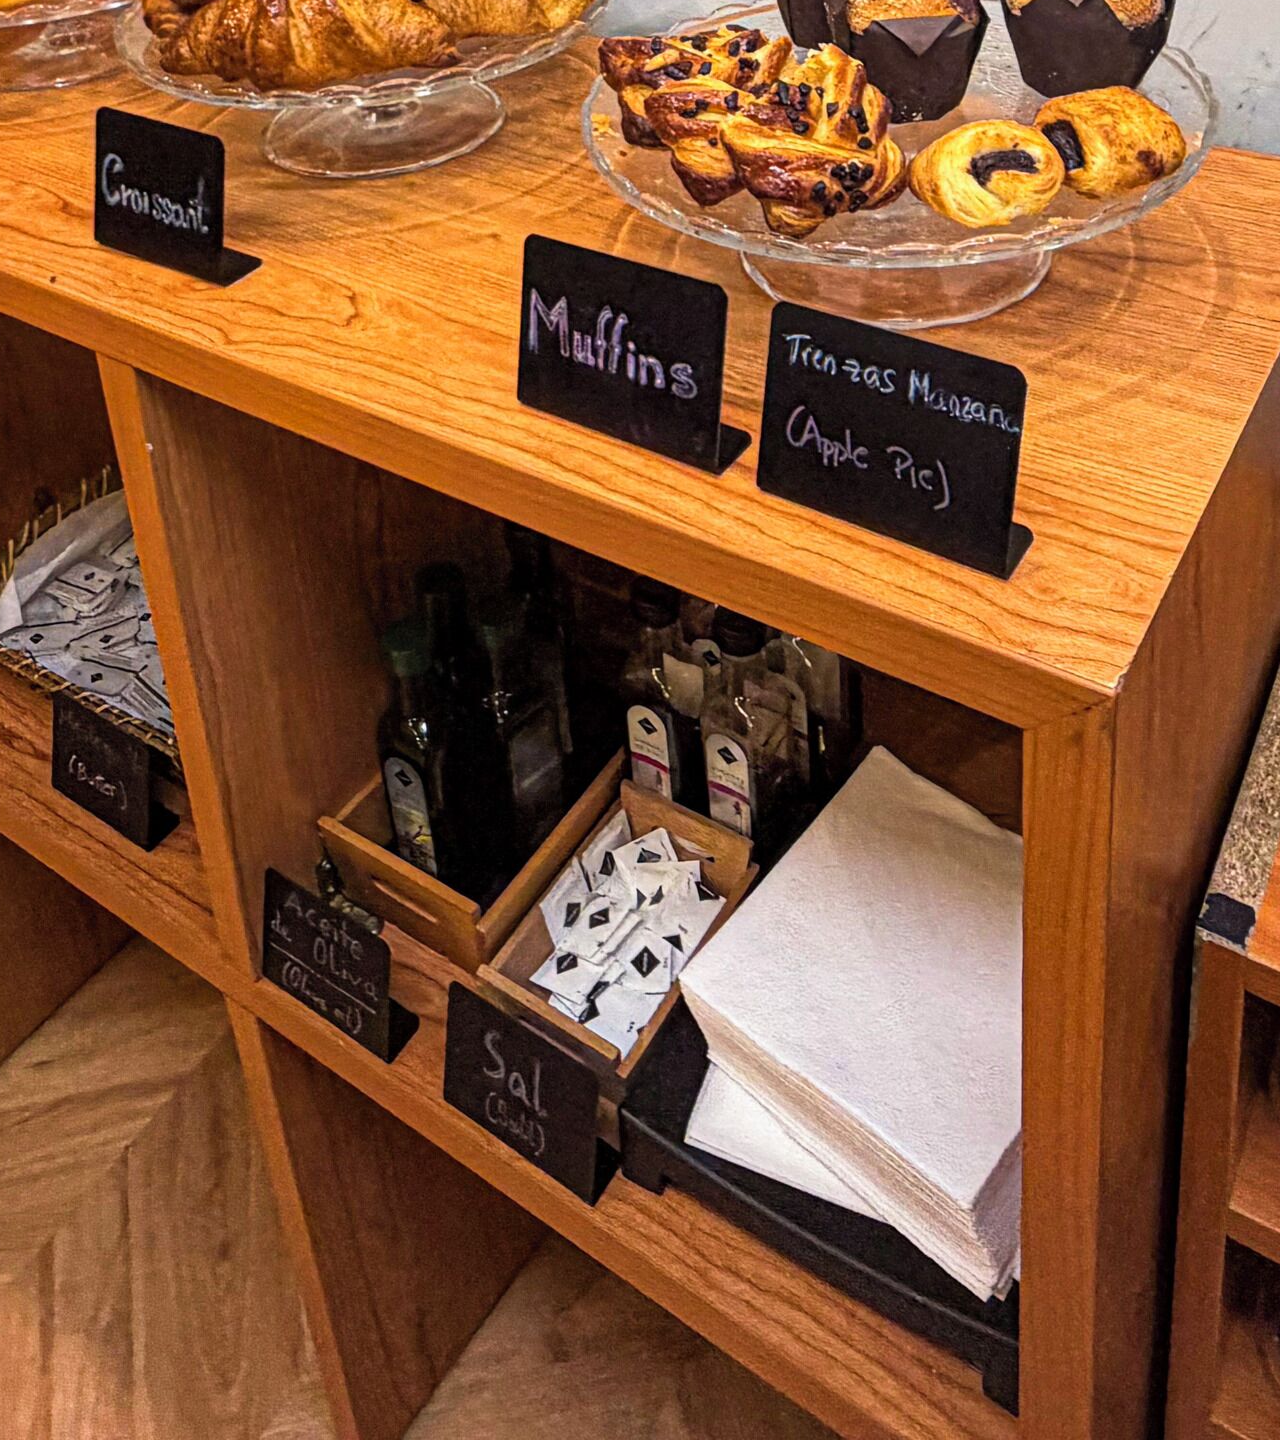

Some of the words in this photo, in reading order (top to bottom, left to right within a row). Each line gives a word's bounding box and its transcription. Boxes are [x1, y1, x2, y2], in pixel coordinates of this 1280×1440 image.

[101, 153, 210, 234] Croissant
[528, 287, 698, 399] Muffins
[782, 333, 897, 394] Trenzas
[785, 404, 870, 469] (Apple
[885, 445, 951, 511] Pie)
[483, 1029, 548, 1117] Sal
